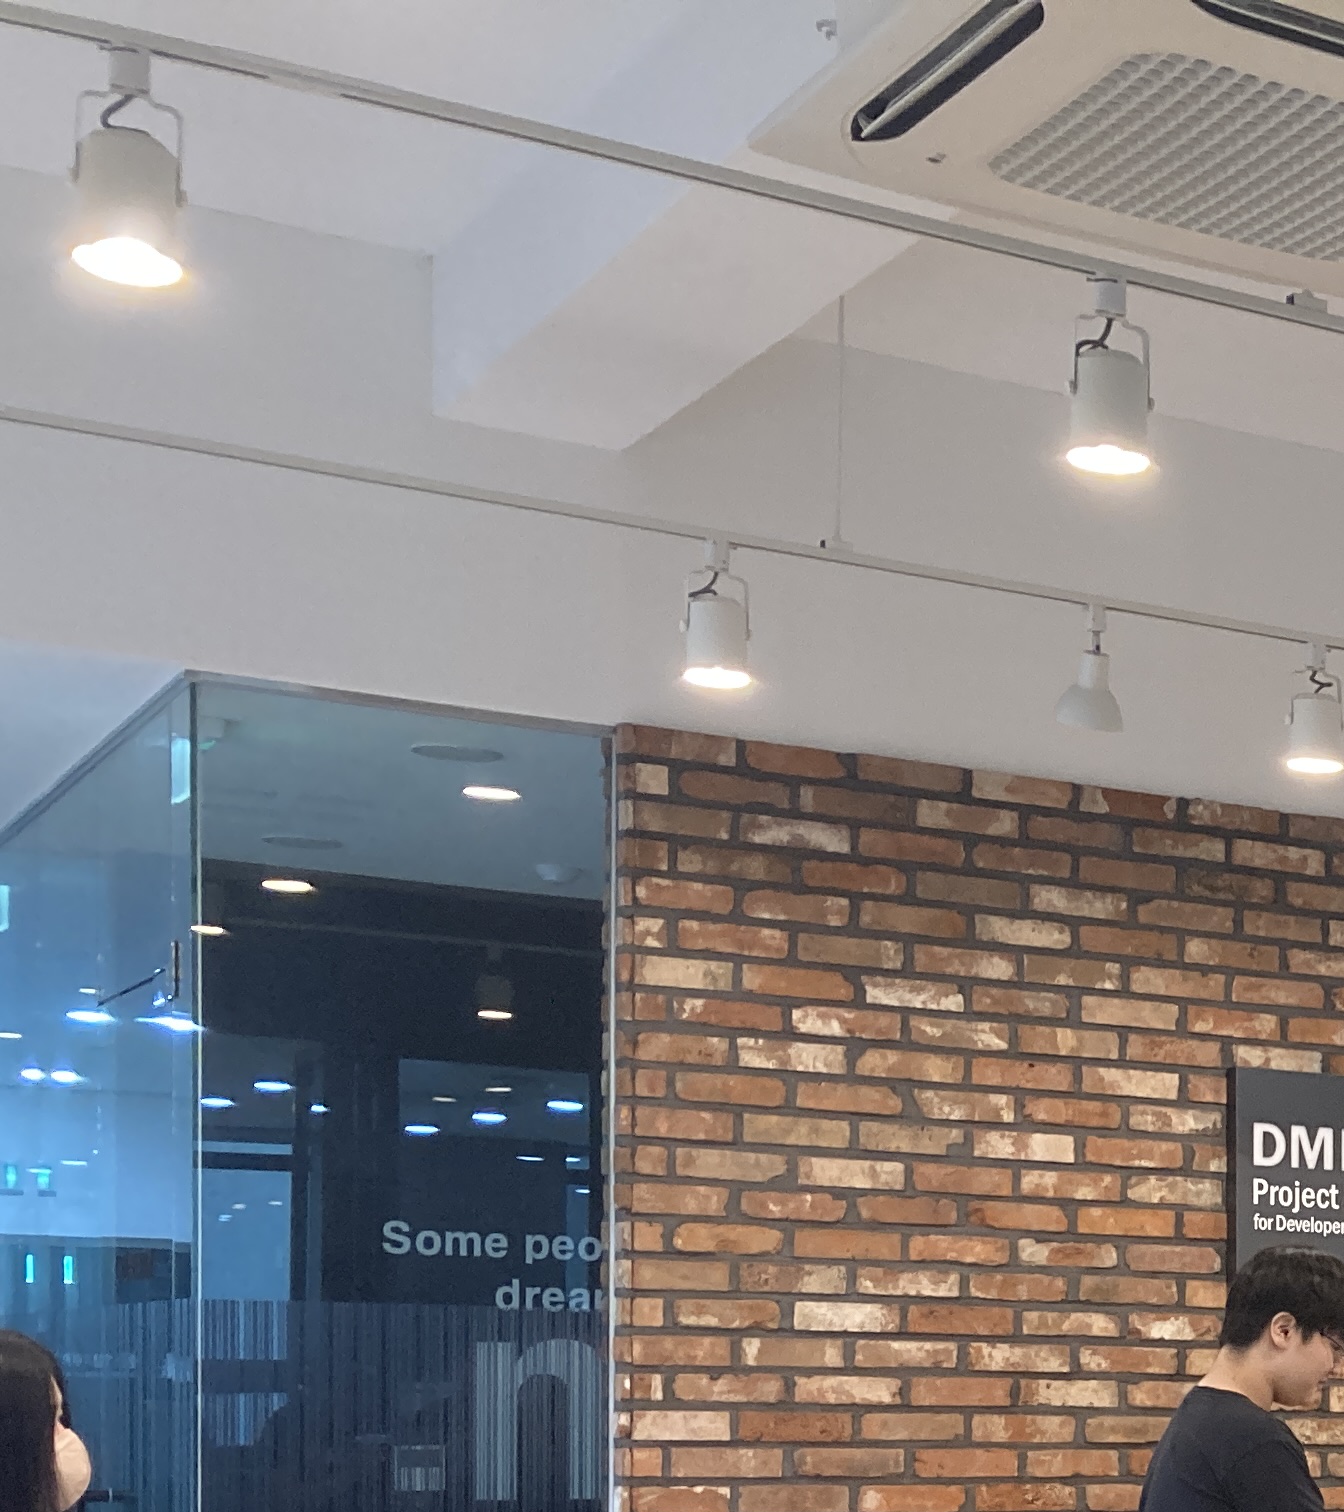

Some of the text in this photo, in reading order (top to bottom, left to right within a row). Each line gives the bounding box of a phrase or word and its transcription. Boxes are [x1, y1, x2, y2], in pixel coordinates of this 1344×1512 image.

[1252, 1178, 1340, 1214] Project
[381, 1219, 509, 1258] Some
[1253, 1213, 1274, 1231] for
